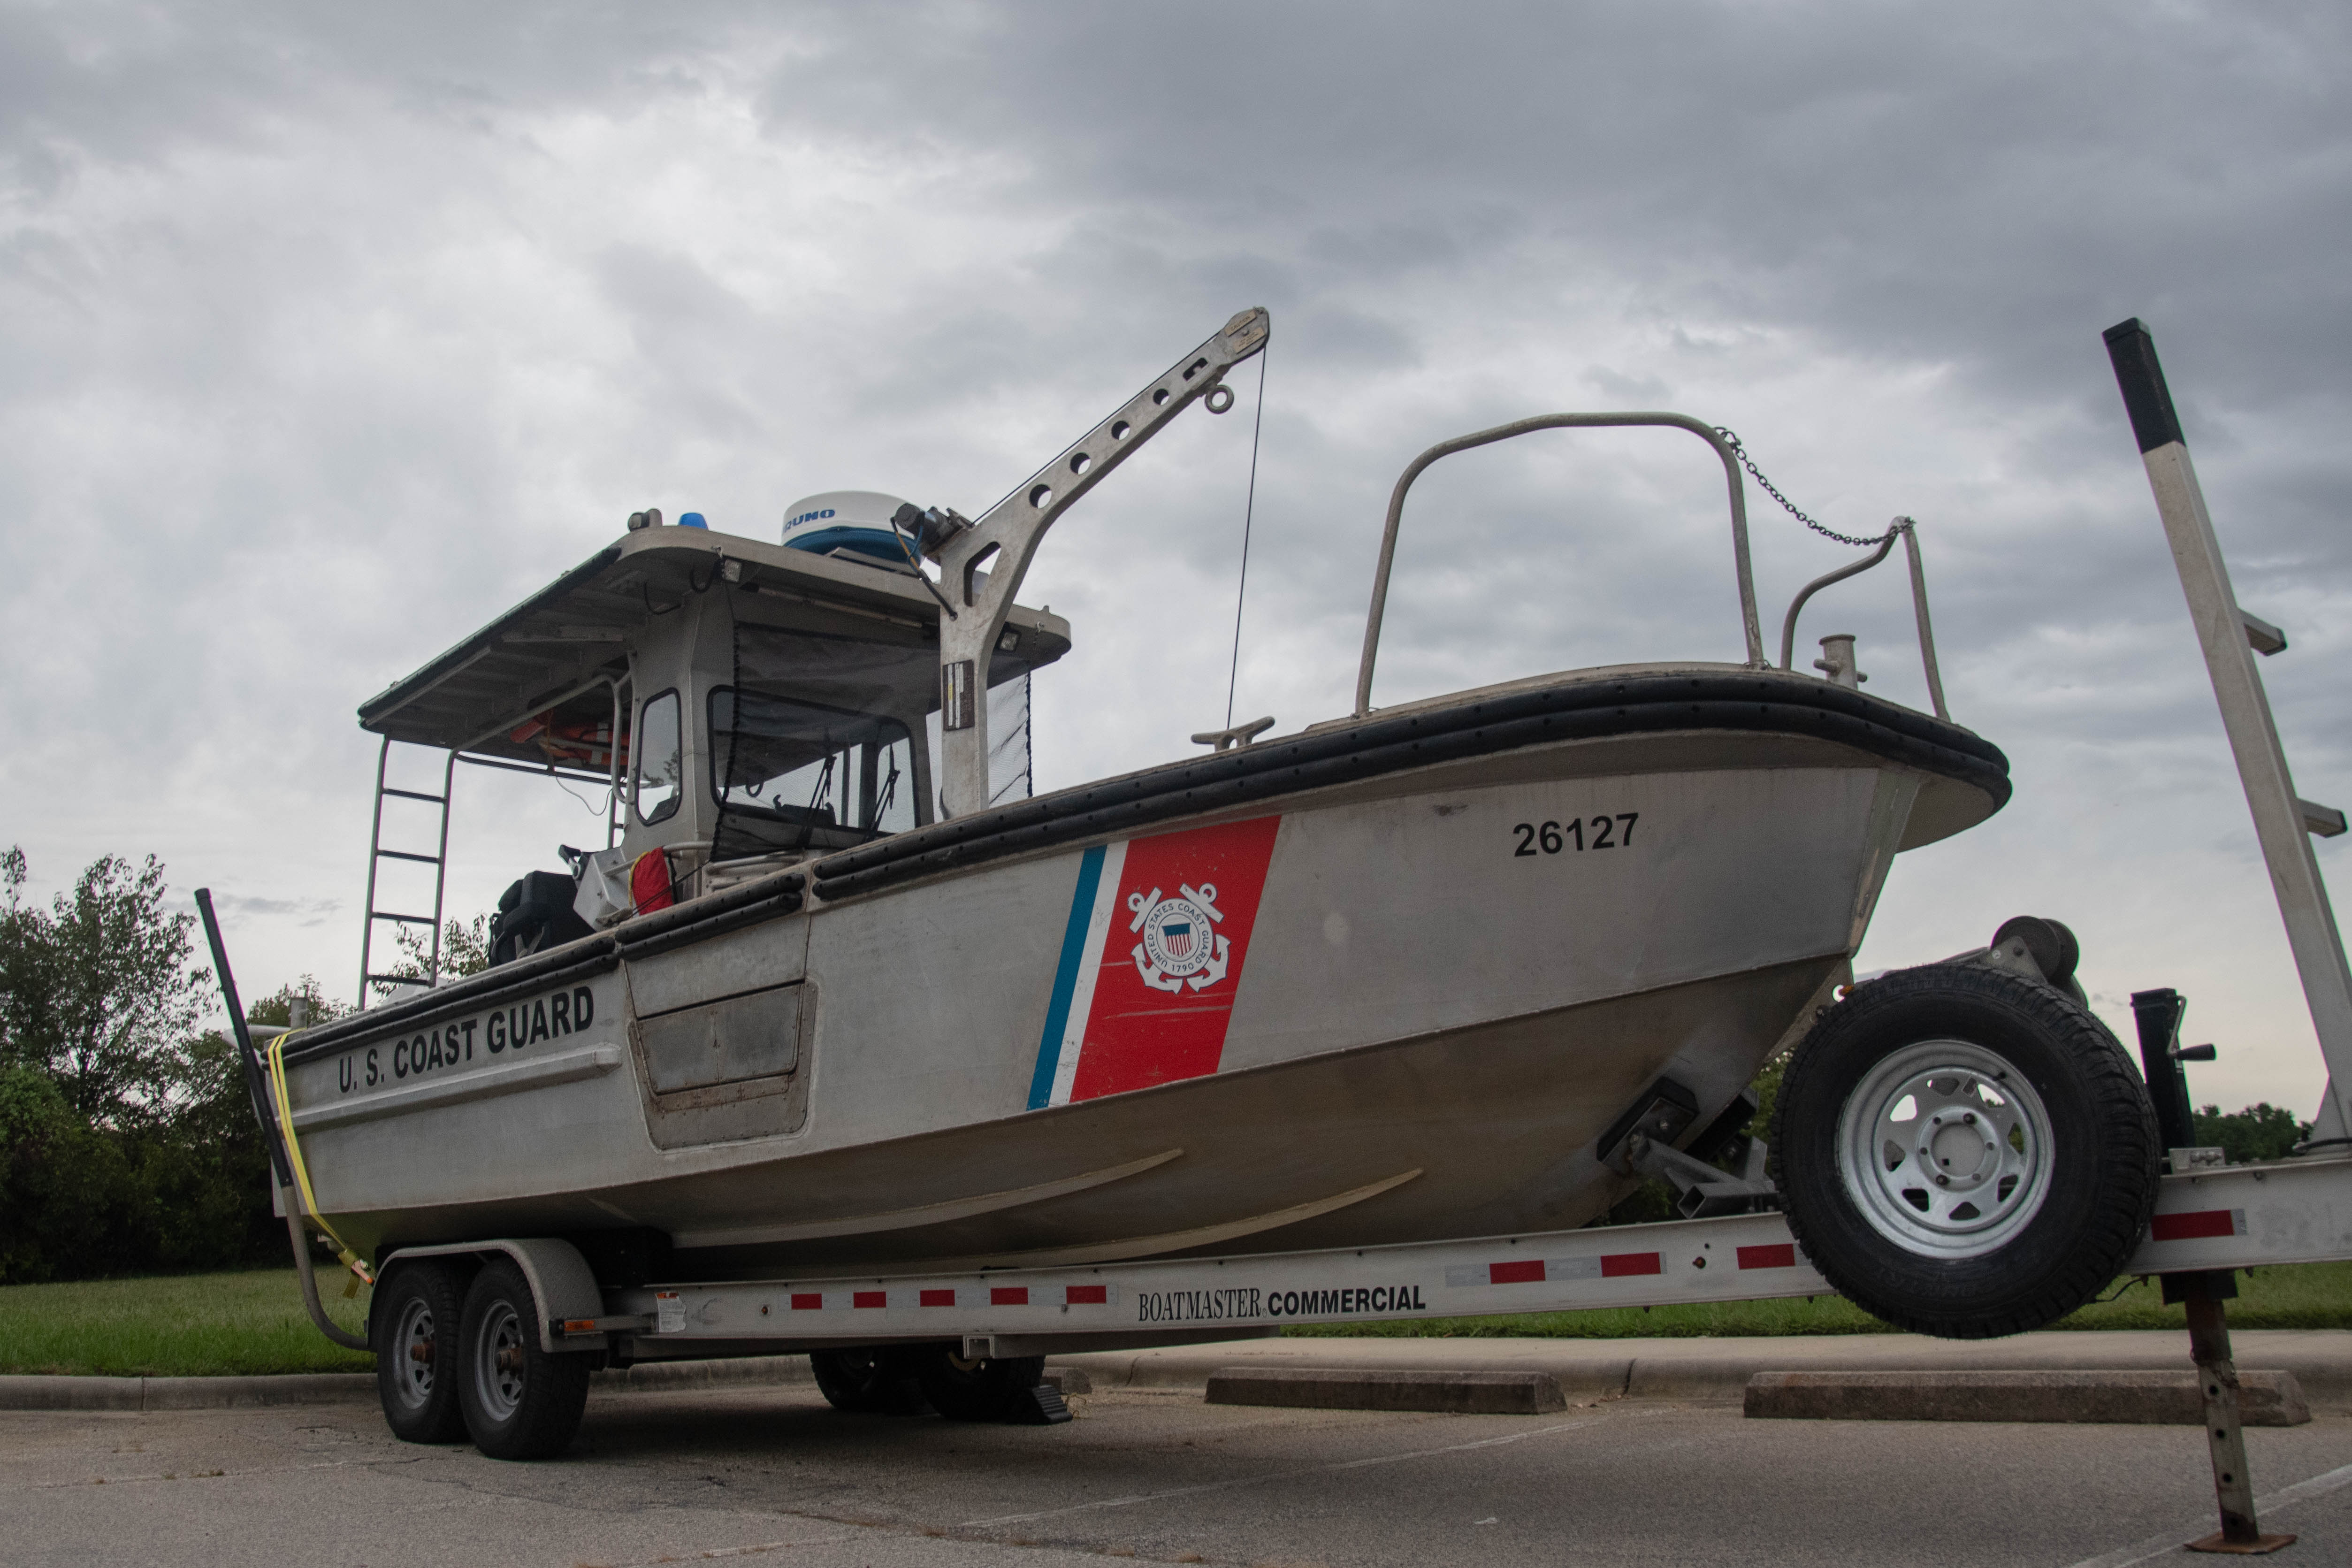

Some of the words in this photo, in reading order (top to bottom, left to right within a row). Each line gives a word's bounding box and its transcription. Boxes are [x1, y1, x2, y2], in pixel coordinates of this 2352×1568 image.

[1513, 812, 1638, 857] 26127
[1148, 903, 1174, 930] STATES
[1178, 903, 1205, 926] COAST
[1147, 933, 1168, 968] UNITED
[1195, 930, 1209, 964] GUARD
[1172, 963, 1194, 973] 1790
[394, 1019, 477, 1079] COAST
[487, 986, 594, 1054] GUARD
[1268, 1285, 1426, 1316] COMMERCIAL
